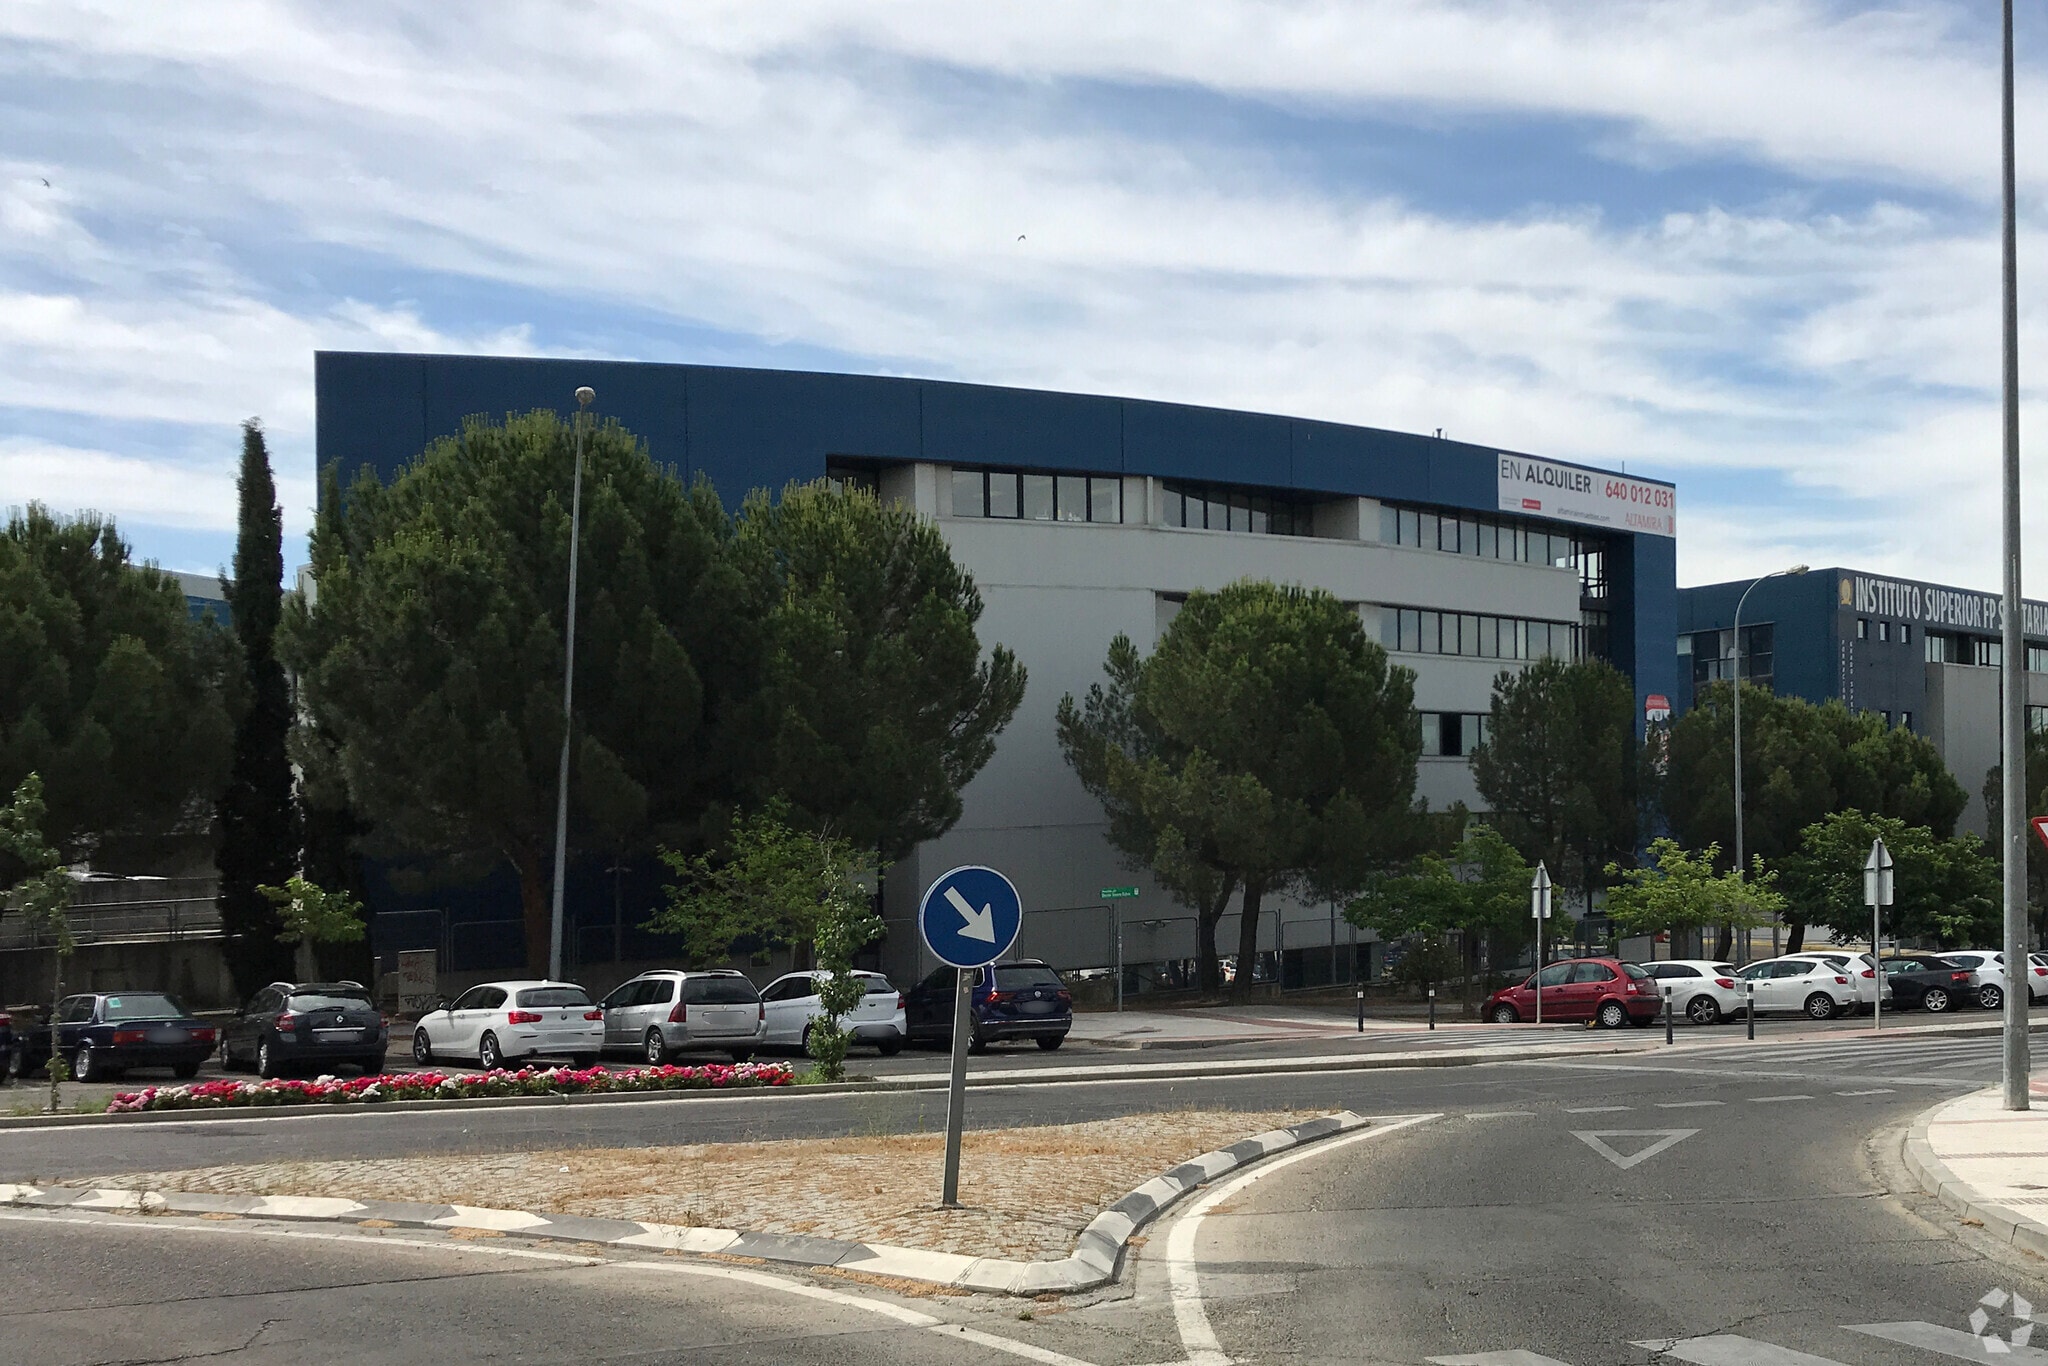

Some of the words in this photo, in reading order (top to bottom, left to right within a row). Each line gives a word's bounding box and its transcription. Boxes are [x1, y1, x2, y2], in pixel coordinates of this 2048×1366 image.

[1501, 459, 1521, 481] EN
[1525, 464, 1591, 494] ALQUILER
[1605, 479, 1627, 501] 640
[1630, 486, 1651, 505] 012
[1654, 491, 1674, 509] 031
[1855, 576, 1921, 620] INSTITUTO
[1925, 588, 1981, 627] SUPERIOR
[1983, 597, 1996, 629] FP
